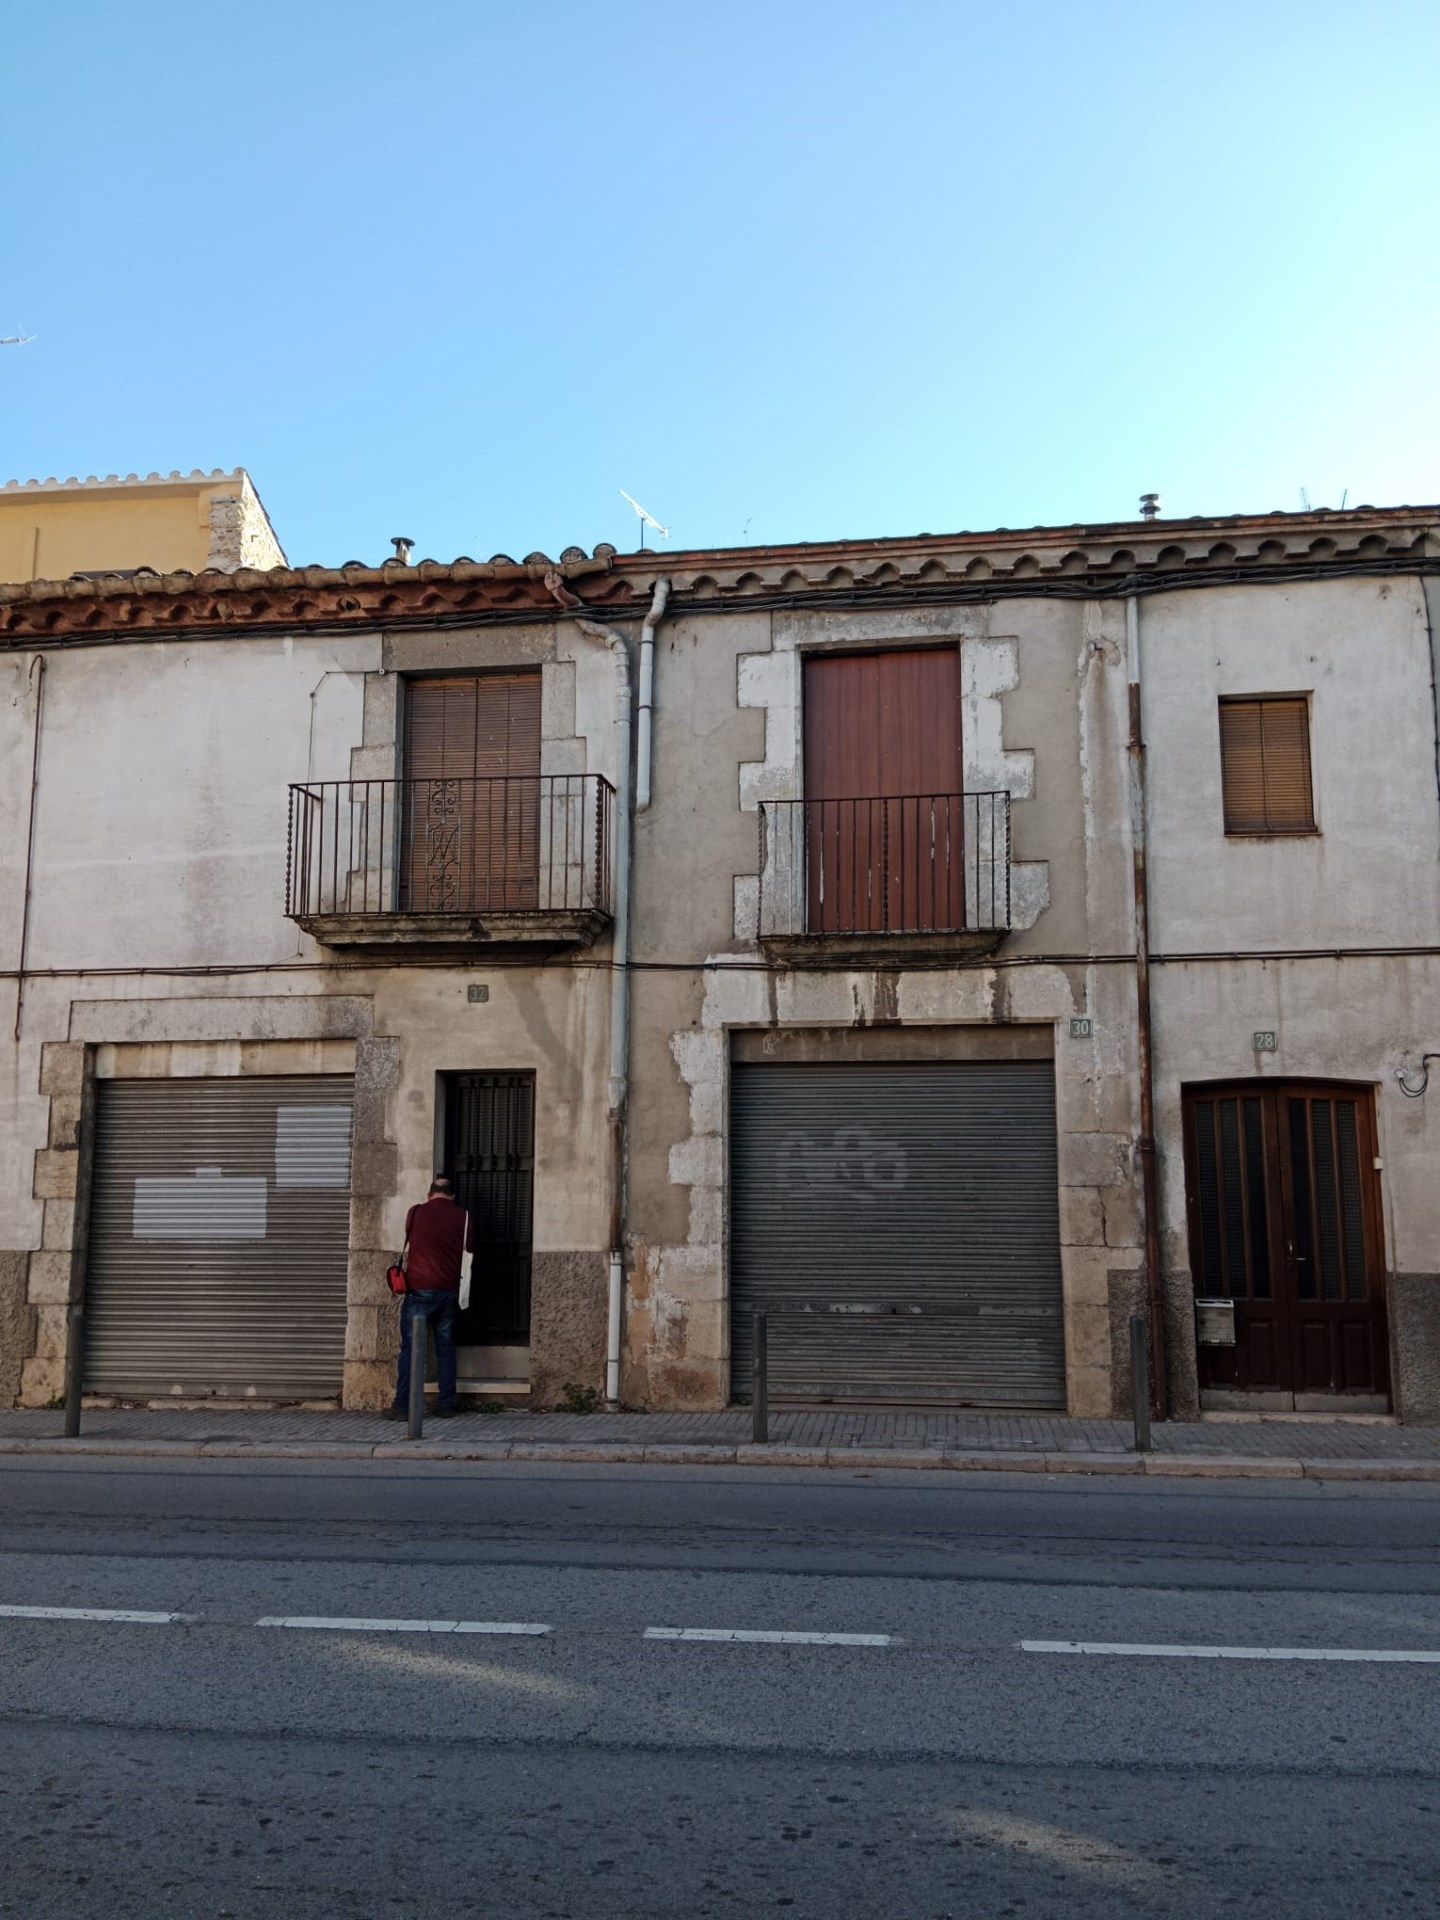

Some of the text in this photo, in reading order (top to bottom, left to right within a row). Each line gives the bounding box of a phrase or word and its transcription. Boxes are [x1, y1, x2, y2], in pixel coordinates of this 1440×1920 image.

[470, 987, 485, 1000] 32
[1073, 1021, 1089, 1035] 30
[1255, 1033, 1274, 1048] 28
